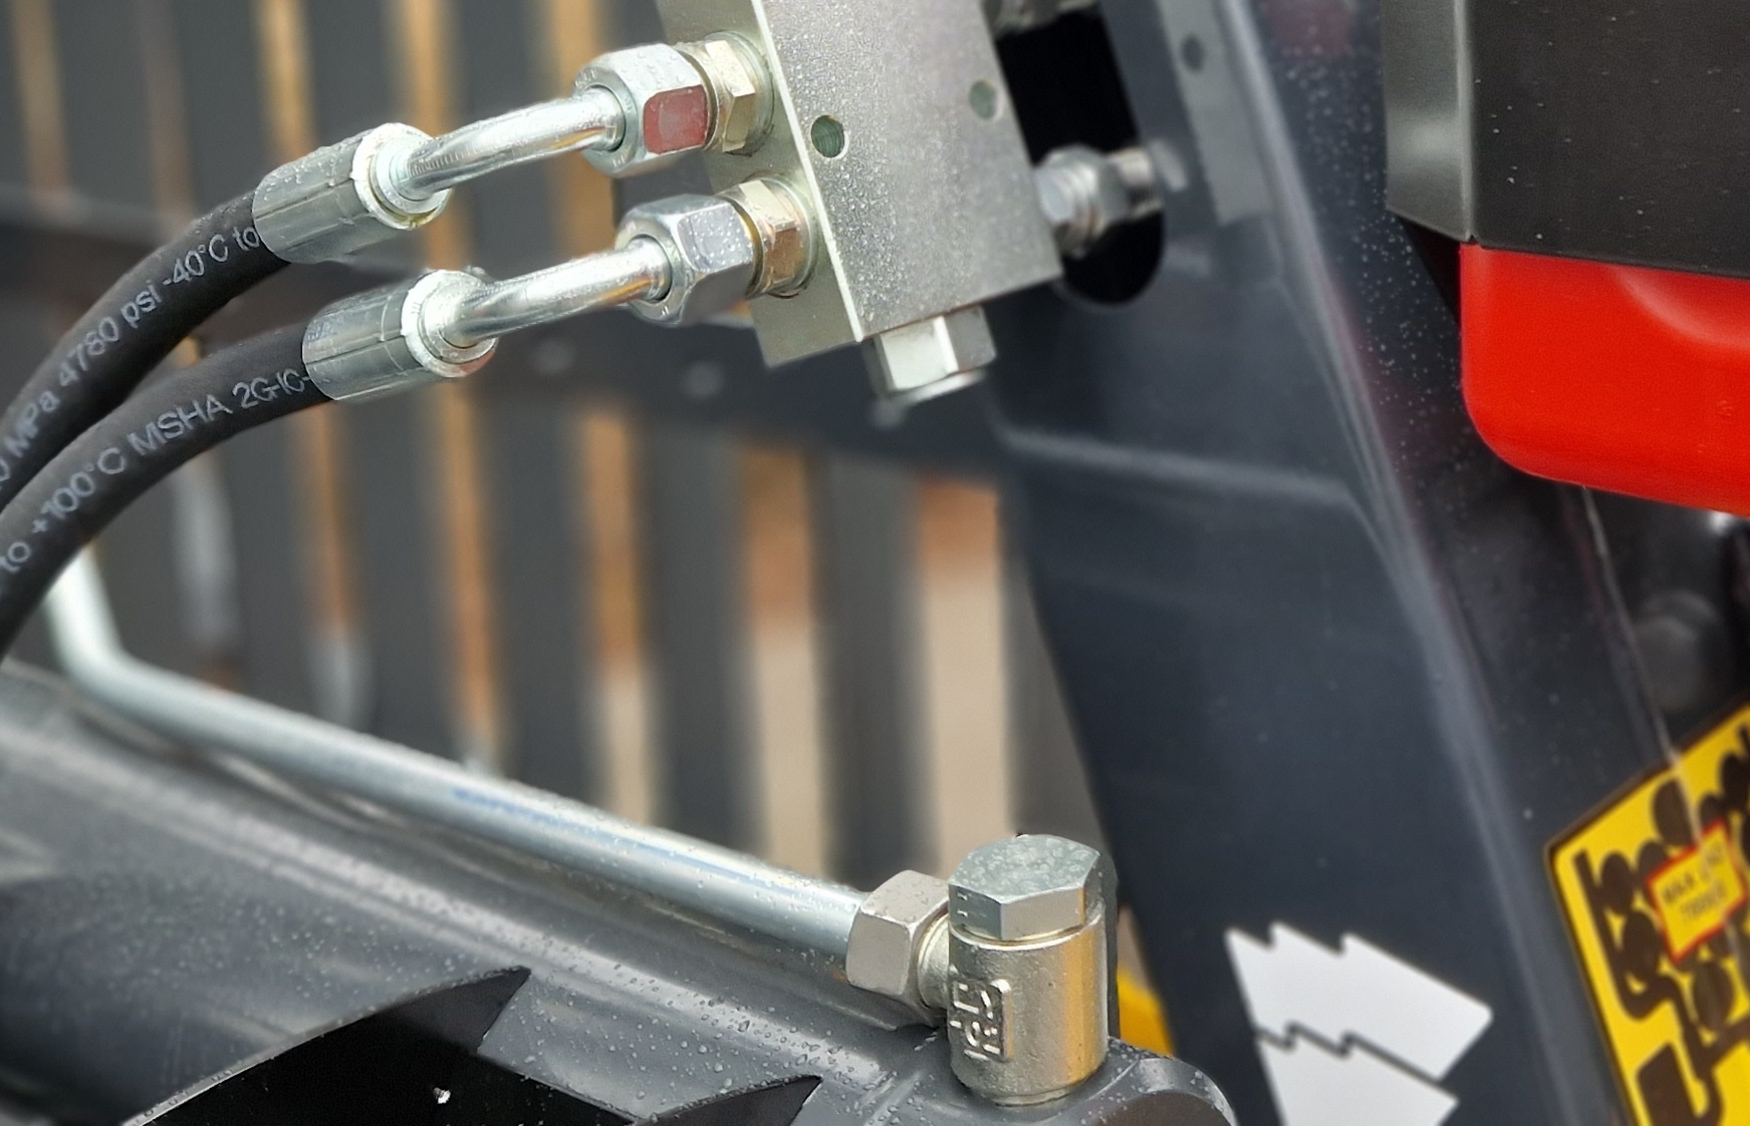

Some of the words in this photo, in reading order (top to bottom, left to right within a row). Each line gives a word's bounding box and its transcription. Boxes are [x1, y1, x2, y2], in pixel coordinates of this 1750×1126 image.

[5, 388, 61, 458] MPa
[59, 316, 120, 387] 4780
[120, 279, 163, 329] psi
[231, 226, 260, 252] to
[32, 447, 127, 534] +100°C
[127, 393, 233, 457] MSHA
